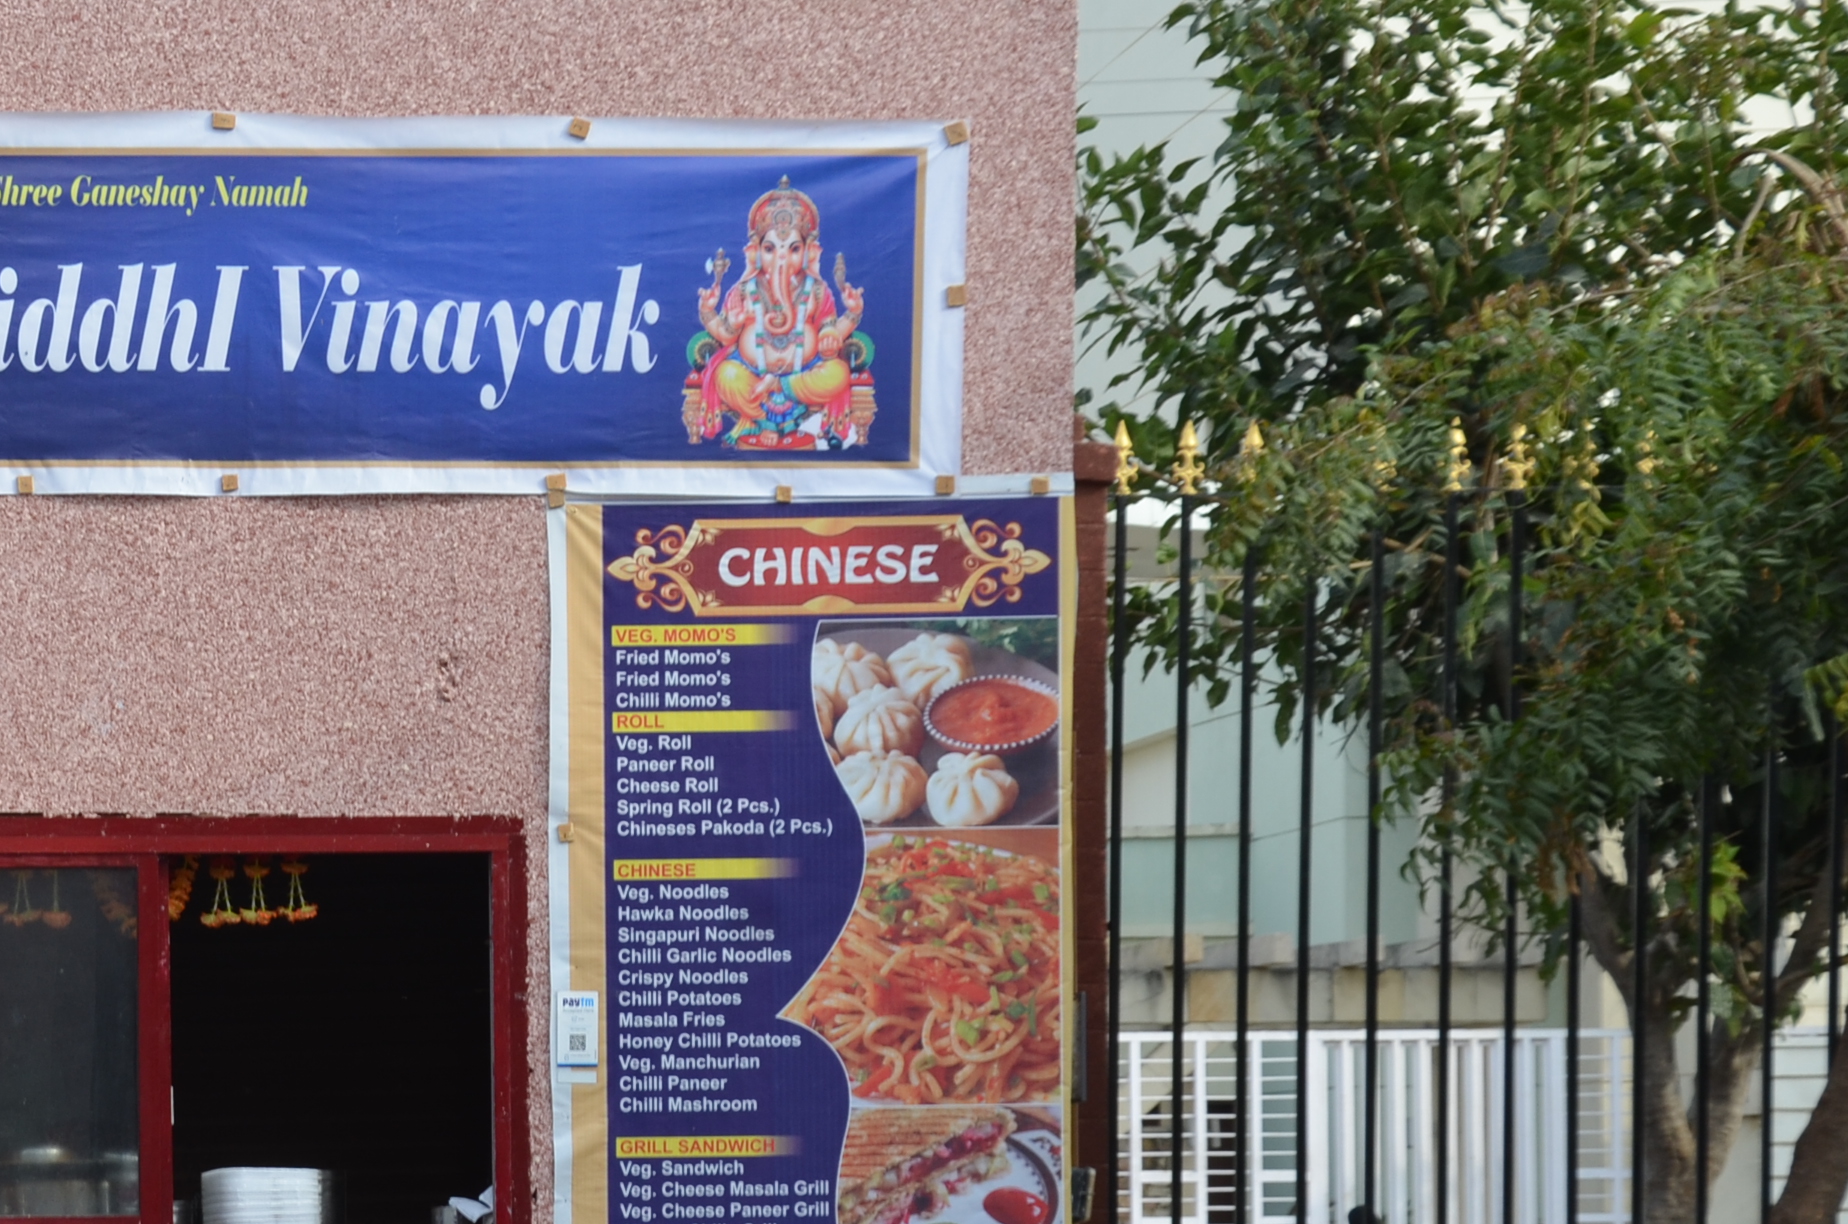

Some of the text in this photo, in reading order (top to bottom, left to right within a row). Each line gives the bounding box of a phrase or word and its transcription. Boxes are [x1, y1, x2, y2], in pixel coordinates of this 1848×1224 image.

[70, 175, 205, 216] Ganeshay
[210, 175, 308, 208] Namah
[272, 263, 660, 410] Vinayak
[718, 544, 940, 587] CHINESE
[616, 628, 736, 643] VEG. MOMO'S
[616, 649, 731, 665] Fried Momo's
[615, 692, 731, 708] Chilli Momo's
[616, 714, 664, 729] ROLL
[615, 735, 692, 754] Veg. Roll
[617, 799, 673, 818] Spring
[678, 799, 712, 813] Roll
[617, 820, 696, 836] Chineses
[701, 819, 765, 835] Pakoda
[618, 863, 696, 878] CHINESE
[617, 884, 729, 903] Veg. Noodles
[618, 926, 775, 946] Singapuri Noodles
[618, 968, 749, 988] Crispy Noodles
[618, 1012, 678, 1027] Masala
[619, 1032, 802, 1052] Honey Chilli Potatoes
[619, 1096, 758, 1112] Chilli Mashroom
[620, 1138, 776, 1154] GRILL SANDWICH
[619, 1159, 744, 1179] Veg. Sandwich
[620, 1201, 830, 1222] Veg. Cheese Paneer Grill
